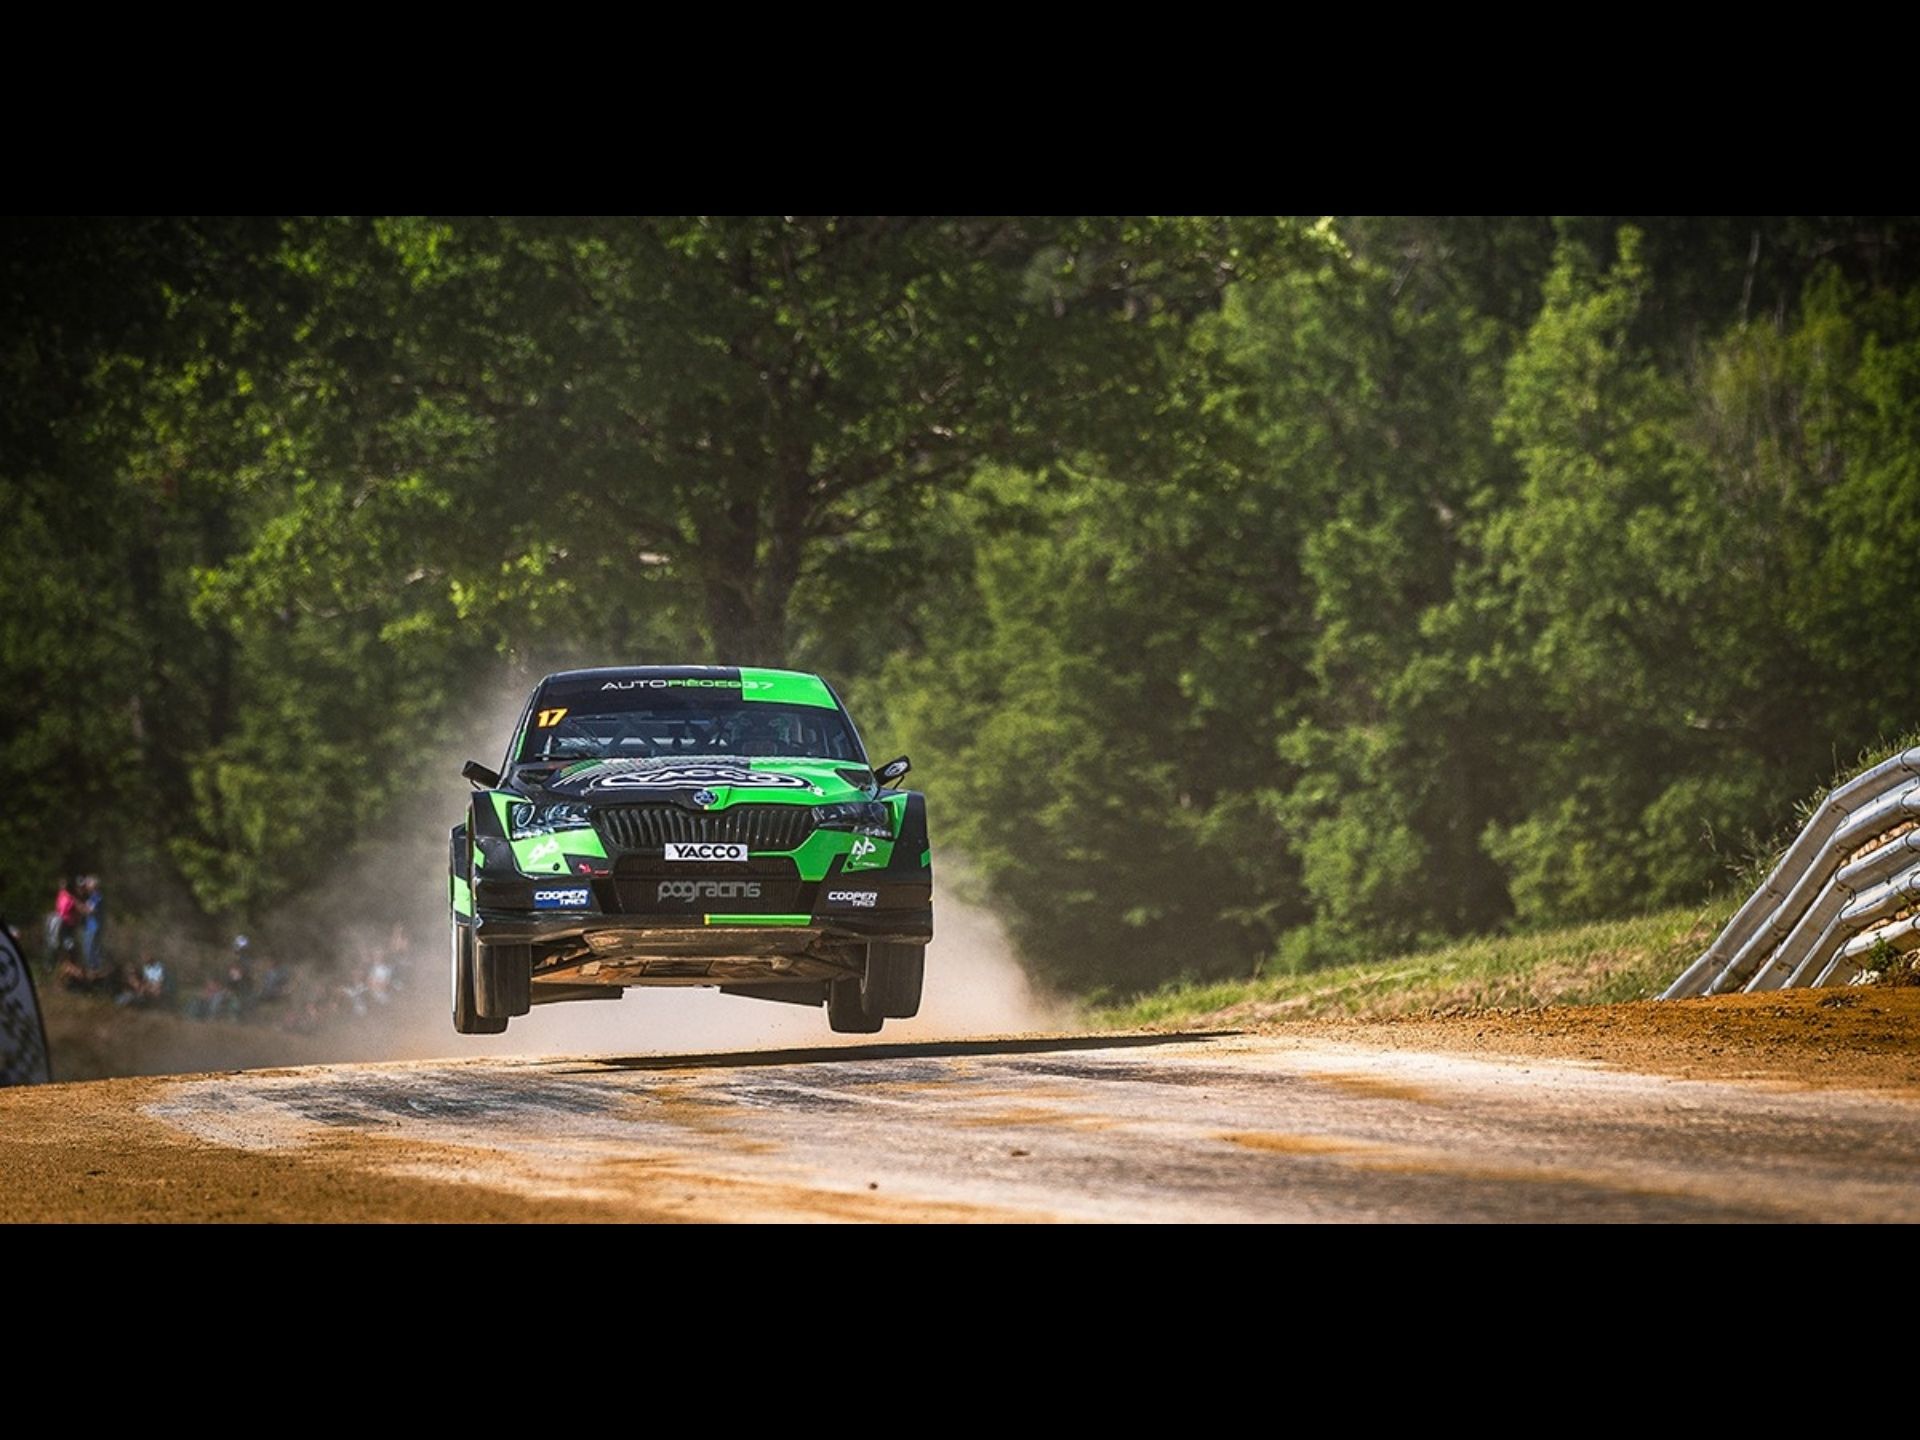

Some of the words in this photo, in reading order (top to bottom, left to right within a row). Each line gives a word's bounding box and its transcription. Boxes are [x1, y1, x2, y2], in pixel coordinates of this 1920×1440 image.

[538, 708, 567, 728] 17
[674, 844, 741, 859] YACCO
[535, 890, 588, 900] COOPER
[828, 891, 878, 901] COOPER
